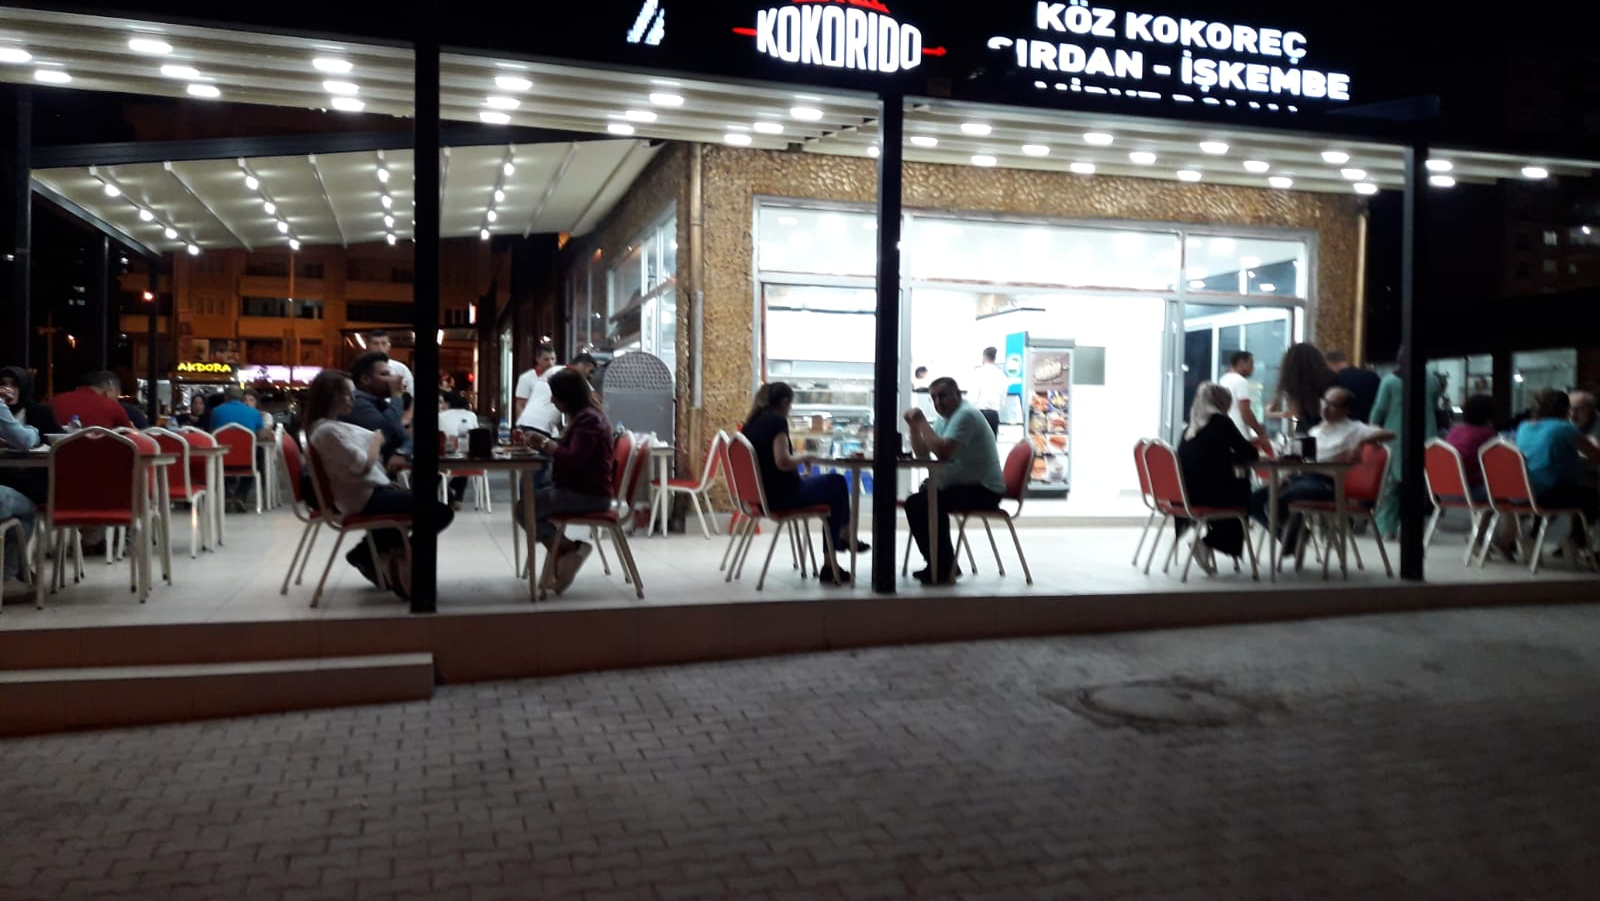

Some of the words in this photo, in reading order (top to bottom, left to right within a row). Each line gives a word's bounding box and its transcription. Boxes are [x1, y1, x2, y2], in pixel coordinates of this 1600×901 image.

[756, 4, 922, 74] KOKORIDO
[1036, 0, 1116, 38] KÖZ
[1126, 11, 1308, 65] KOKOREÇ
[1180, 49, 1351, 102] İŞKEMBE
[177, 362, 232, 373] AKDORA
